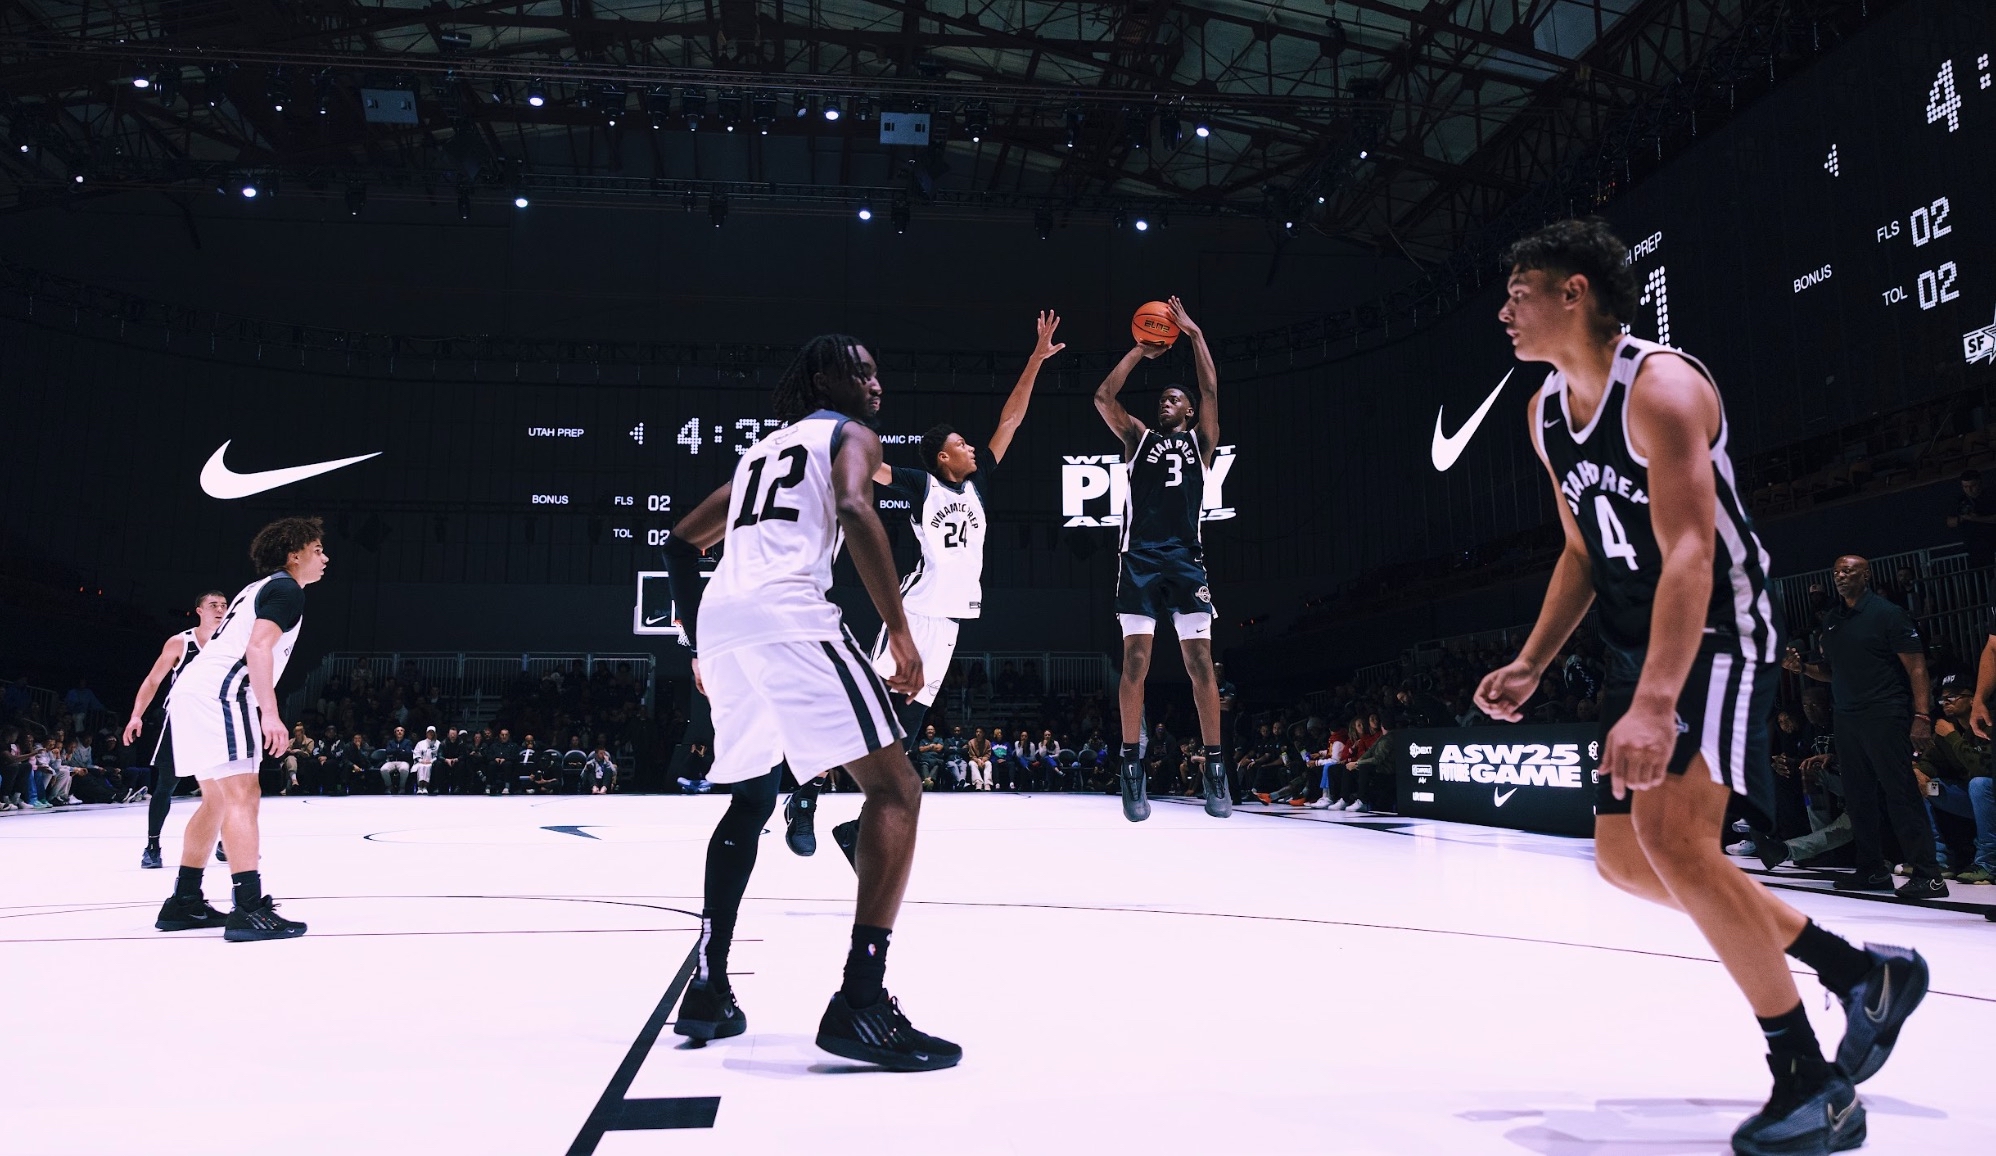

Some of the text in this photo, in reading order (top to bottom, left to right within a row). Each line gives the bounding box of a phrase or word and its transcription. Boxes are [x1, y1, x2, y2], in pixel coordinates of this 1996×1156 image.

[1876, 196, 1952, 248] FLS 02
[1633, 230, 1662, 262] PREP
[1793, 263, 1833, 294] BONUS
[1881, 260, 1960, 311] TOL 02
[1968, 334, 1985, 354] SF
[528, 427, 585, 438] UTAH PREP
[1062, 454, 1120, 464] WE
[1146, 438, 1173, 464] UTAH
[1175, 439, 1196, 465] PREP
[1165, 453, 1183, 487] 3
[531, 494, 569, 505] BONUS
[733, 444, 809, 531] 12
[614, 494, 671, 512] FLS 02
[930, 502, 966, 529] DYNAMIC
[612, 528, 671, 546] TOL 02
[944, 520, 967, 548] 24
[1594, 495, 1639, 571] 4
[1439, 744, 1581, 766] ASW25
[1470, 763, 1583, 788] GAME
